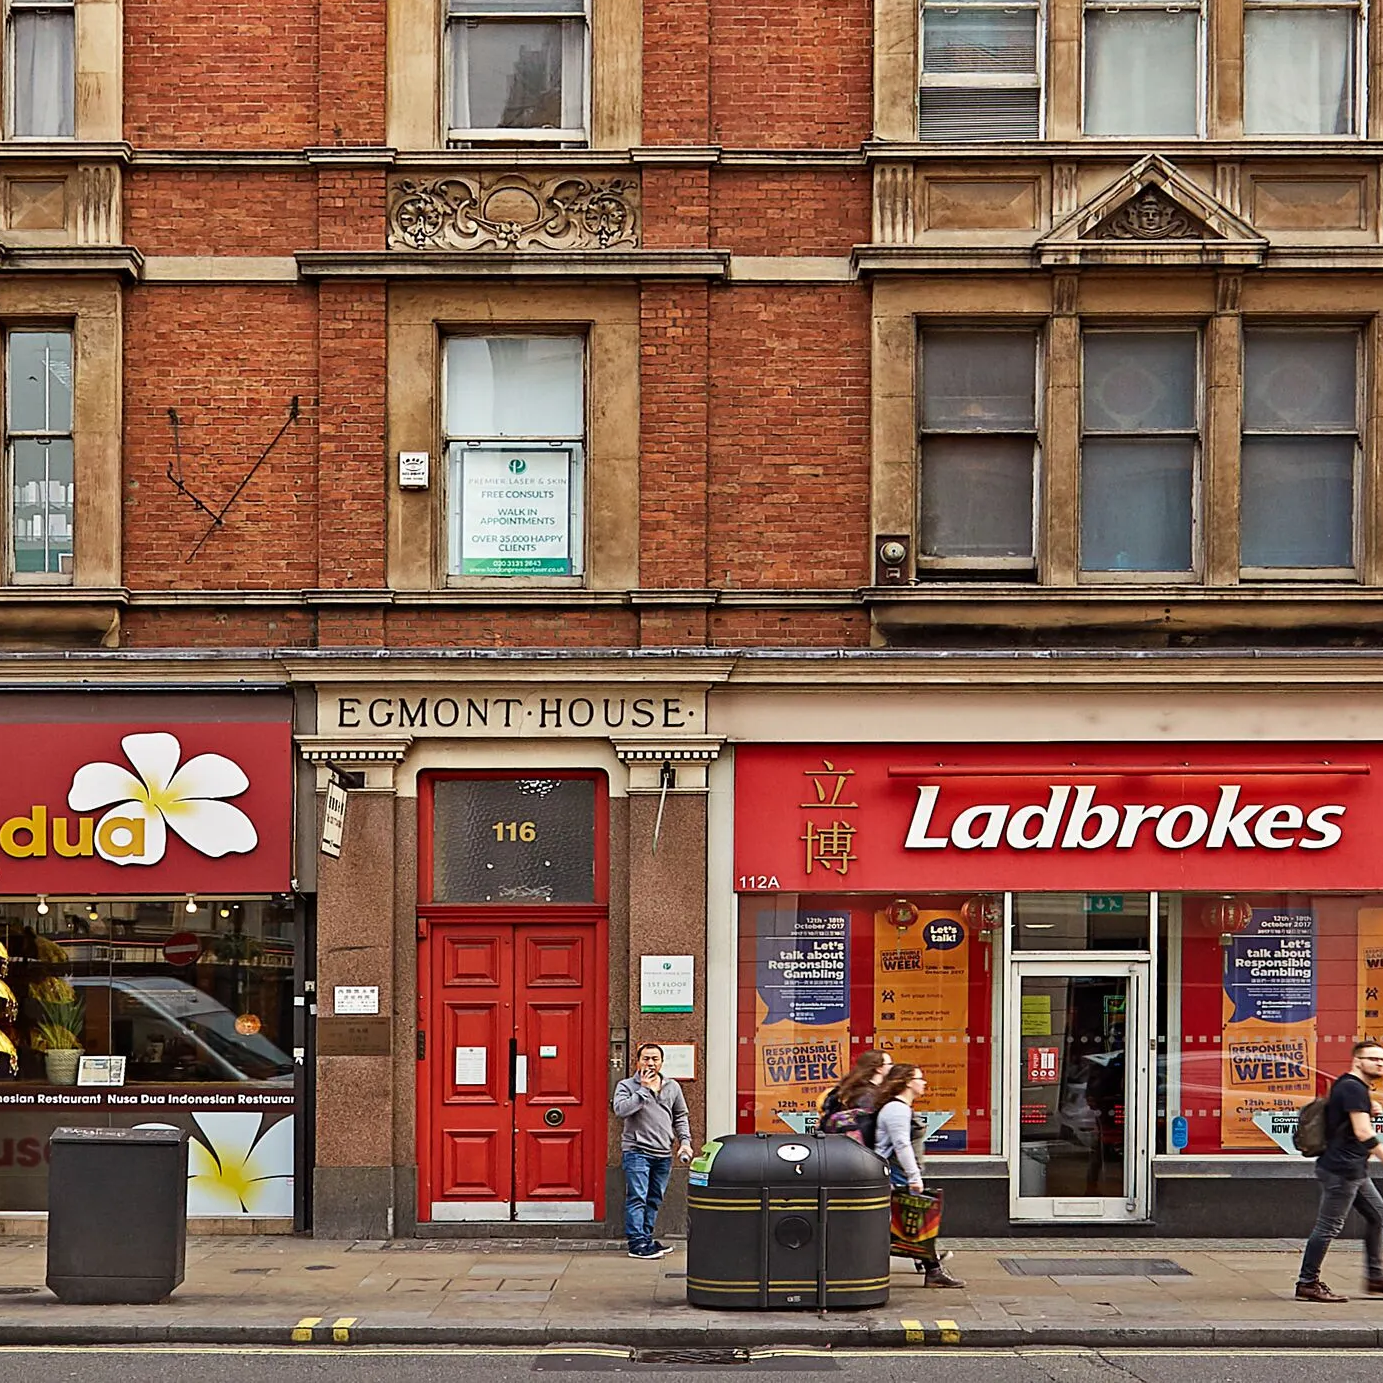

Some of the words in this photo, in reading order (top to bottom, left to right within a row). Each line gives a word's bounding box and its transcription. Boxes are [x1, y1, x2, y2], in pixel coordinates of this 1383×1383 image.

[497, 508, 526, 516] WALK
[527, 508, 538, 516] IN
[480, 517, 555, 525] APPOINTMENTS
[471, 535, 498, 543] OVER
[530, 535, 563, 543] HAPPY
[498, 544, 536, 552] CLIENTS
[799, 760, 859, 875] 立博
[904, 784, 1347, 850] Ladbrokes
[492, 821, 536, 842] 116
[739, 875, 780, 889] 112A
[930, 926, 958, 934] Let's
[931, 934, 956, 942] talk!
[1280, 939, 1311, 948] Let's
[813, 941, 844, 950] Let's
[780, 951, 804, 960] talk
[806, 951, 845, 960] about
[1247, 949, 1271, 958] talk
[1273, 949, 1311, 958] about
[768, 960, 844, 971] Responsible
[884, 960, 921, 971] WEEK
[1235, 958, 1311, 968] Responsible
[783, 969, 844, 980] Gambling
[1250, 967, 1311, 978] Gambling
[765, 1044, 837, 1056] RESPONSIBLE
[1231, 1043, 1303, 1054] RESPONSIBLE
[766, 1052, 837, 1065] GAMBLING
[1232, 1051, 1304, 1064] GAMBLING
[768, 1062, 839, 1083] WEEK
[1234, 1061, 1306, 1081] WEEK
[37, 1093, 102, 1104] Restaurant
[107, 1093, 138, 1104] Nusa
[141, 1093, 165, 1104] Dua
[168, 1093, 235, 1104] Indonesian
[778, 1100, 798, 1108] 12th
[1271, 1124, 1290, 1134] NOW
